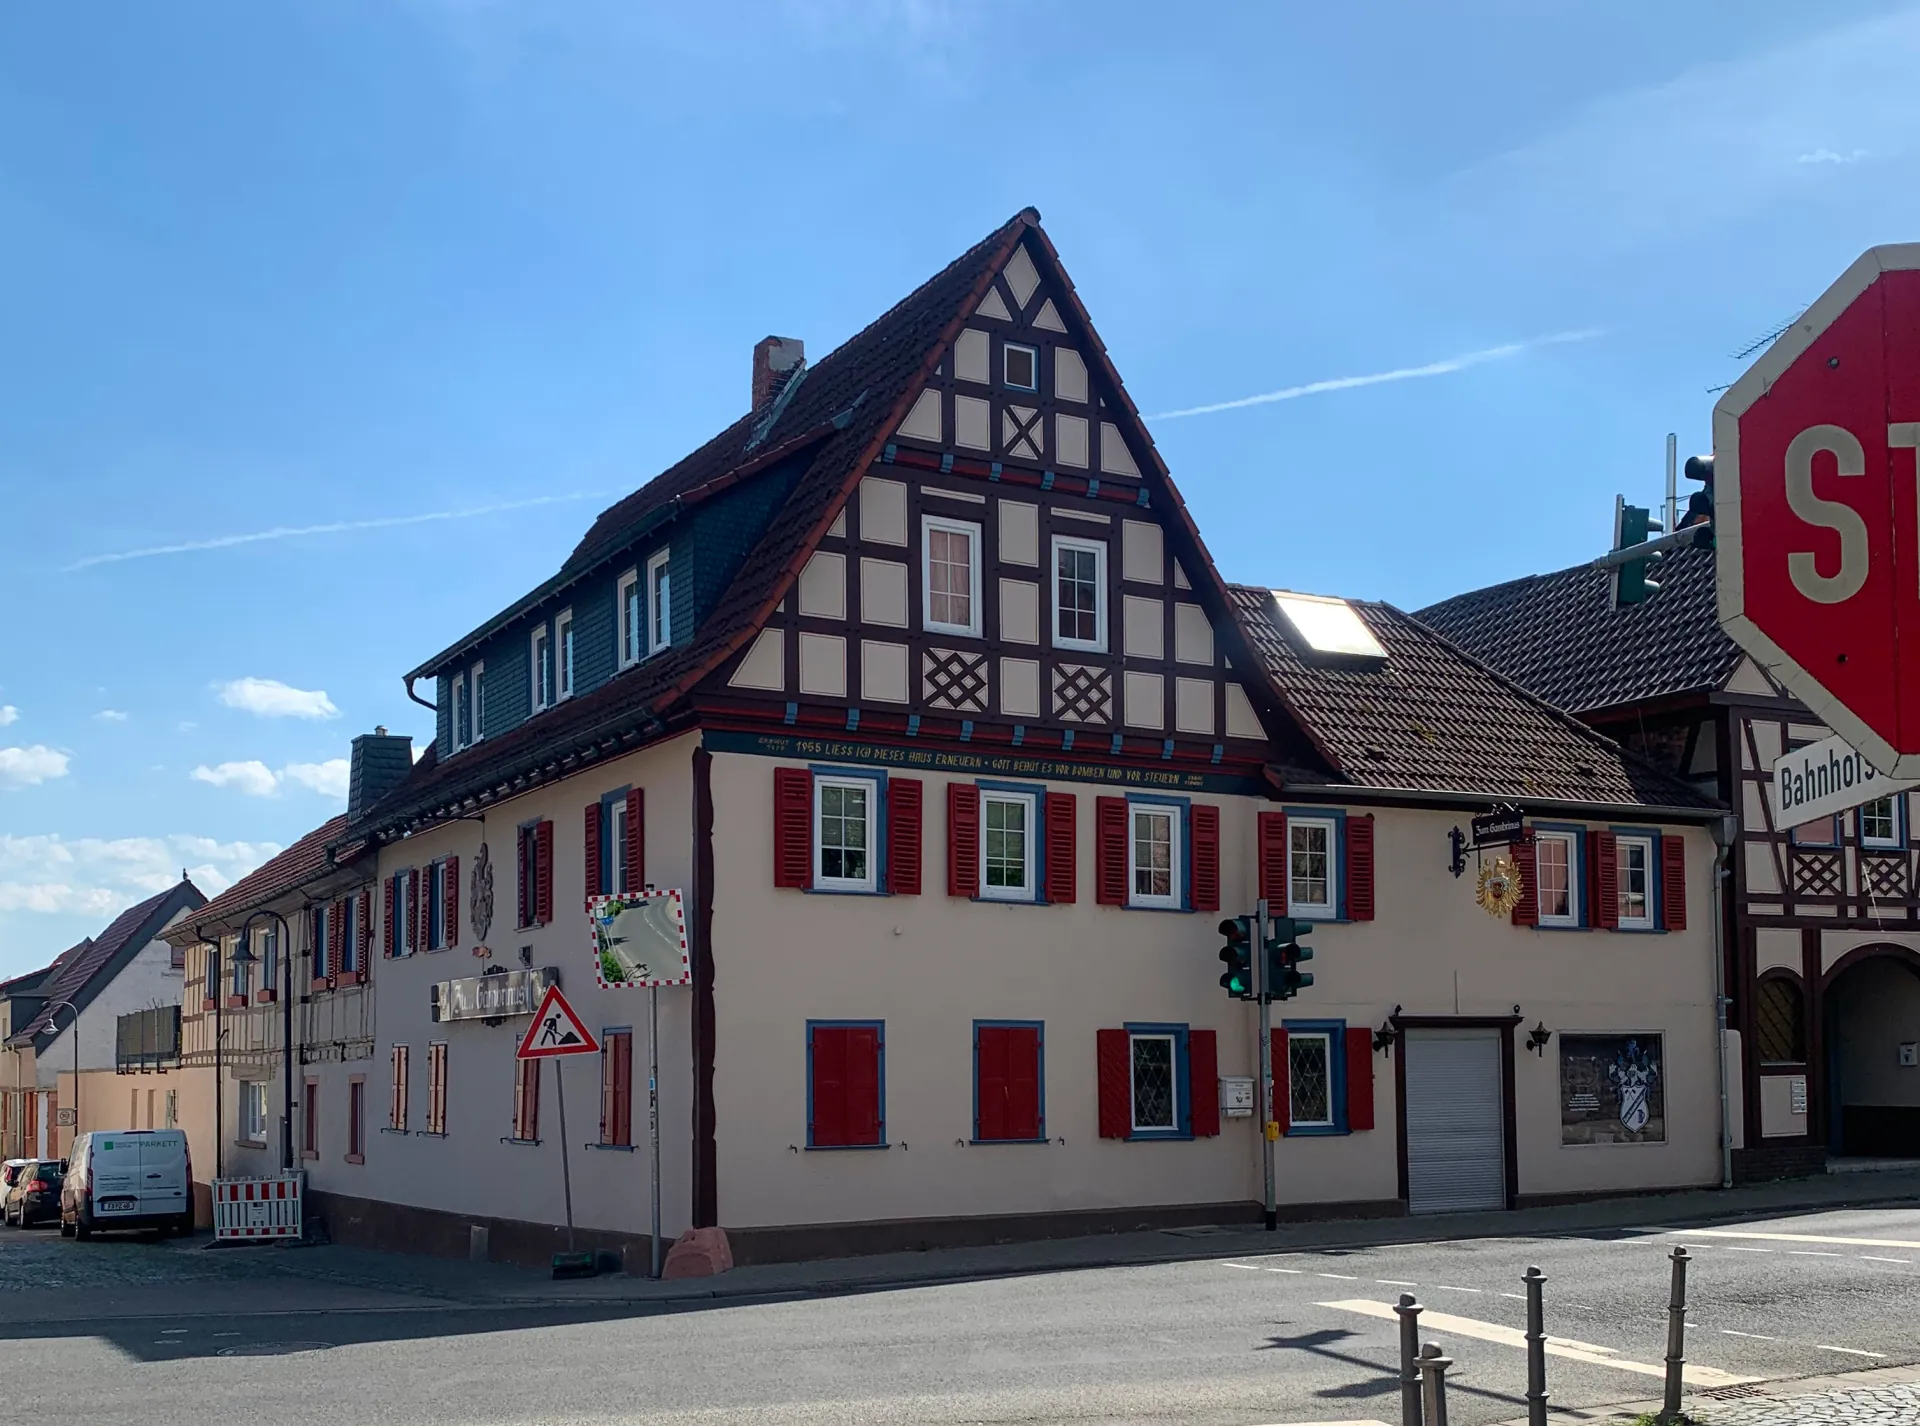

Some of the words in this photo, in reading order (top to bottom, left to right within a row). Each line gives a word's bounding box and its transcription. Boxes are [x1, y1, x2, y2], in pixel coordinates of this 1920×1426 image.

[1785, 423, 1920, 604] S
[825, 743, 853, 756] LIESS
[874, 748, 905, 761] DIESES
[908, 751, 932, 763] HAUS
[936, 753, 982, 768] ERNEUERN
[992, 759, 1011, 770] GOTT
[1041, 762, 1053, 773] ES
[1055, 764, 1070, 776] VOR
[1072, 766, 1105, 779] BOMBEN
[1107, 768, 1122, 780] UND
[1126, 769, 1141, 781] VOR
[1144, 772, 1180, 785] STEUERN
[1781, 749, 1884, 811] Bahnhofs
[1475, 825, 1489, 836] Zum
[1490, 821, 1520, 833] Gambrinus
[476, 981, 525, 1011] Gambrinus
